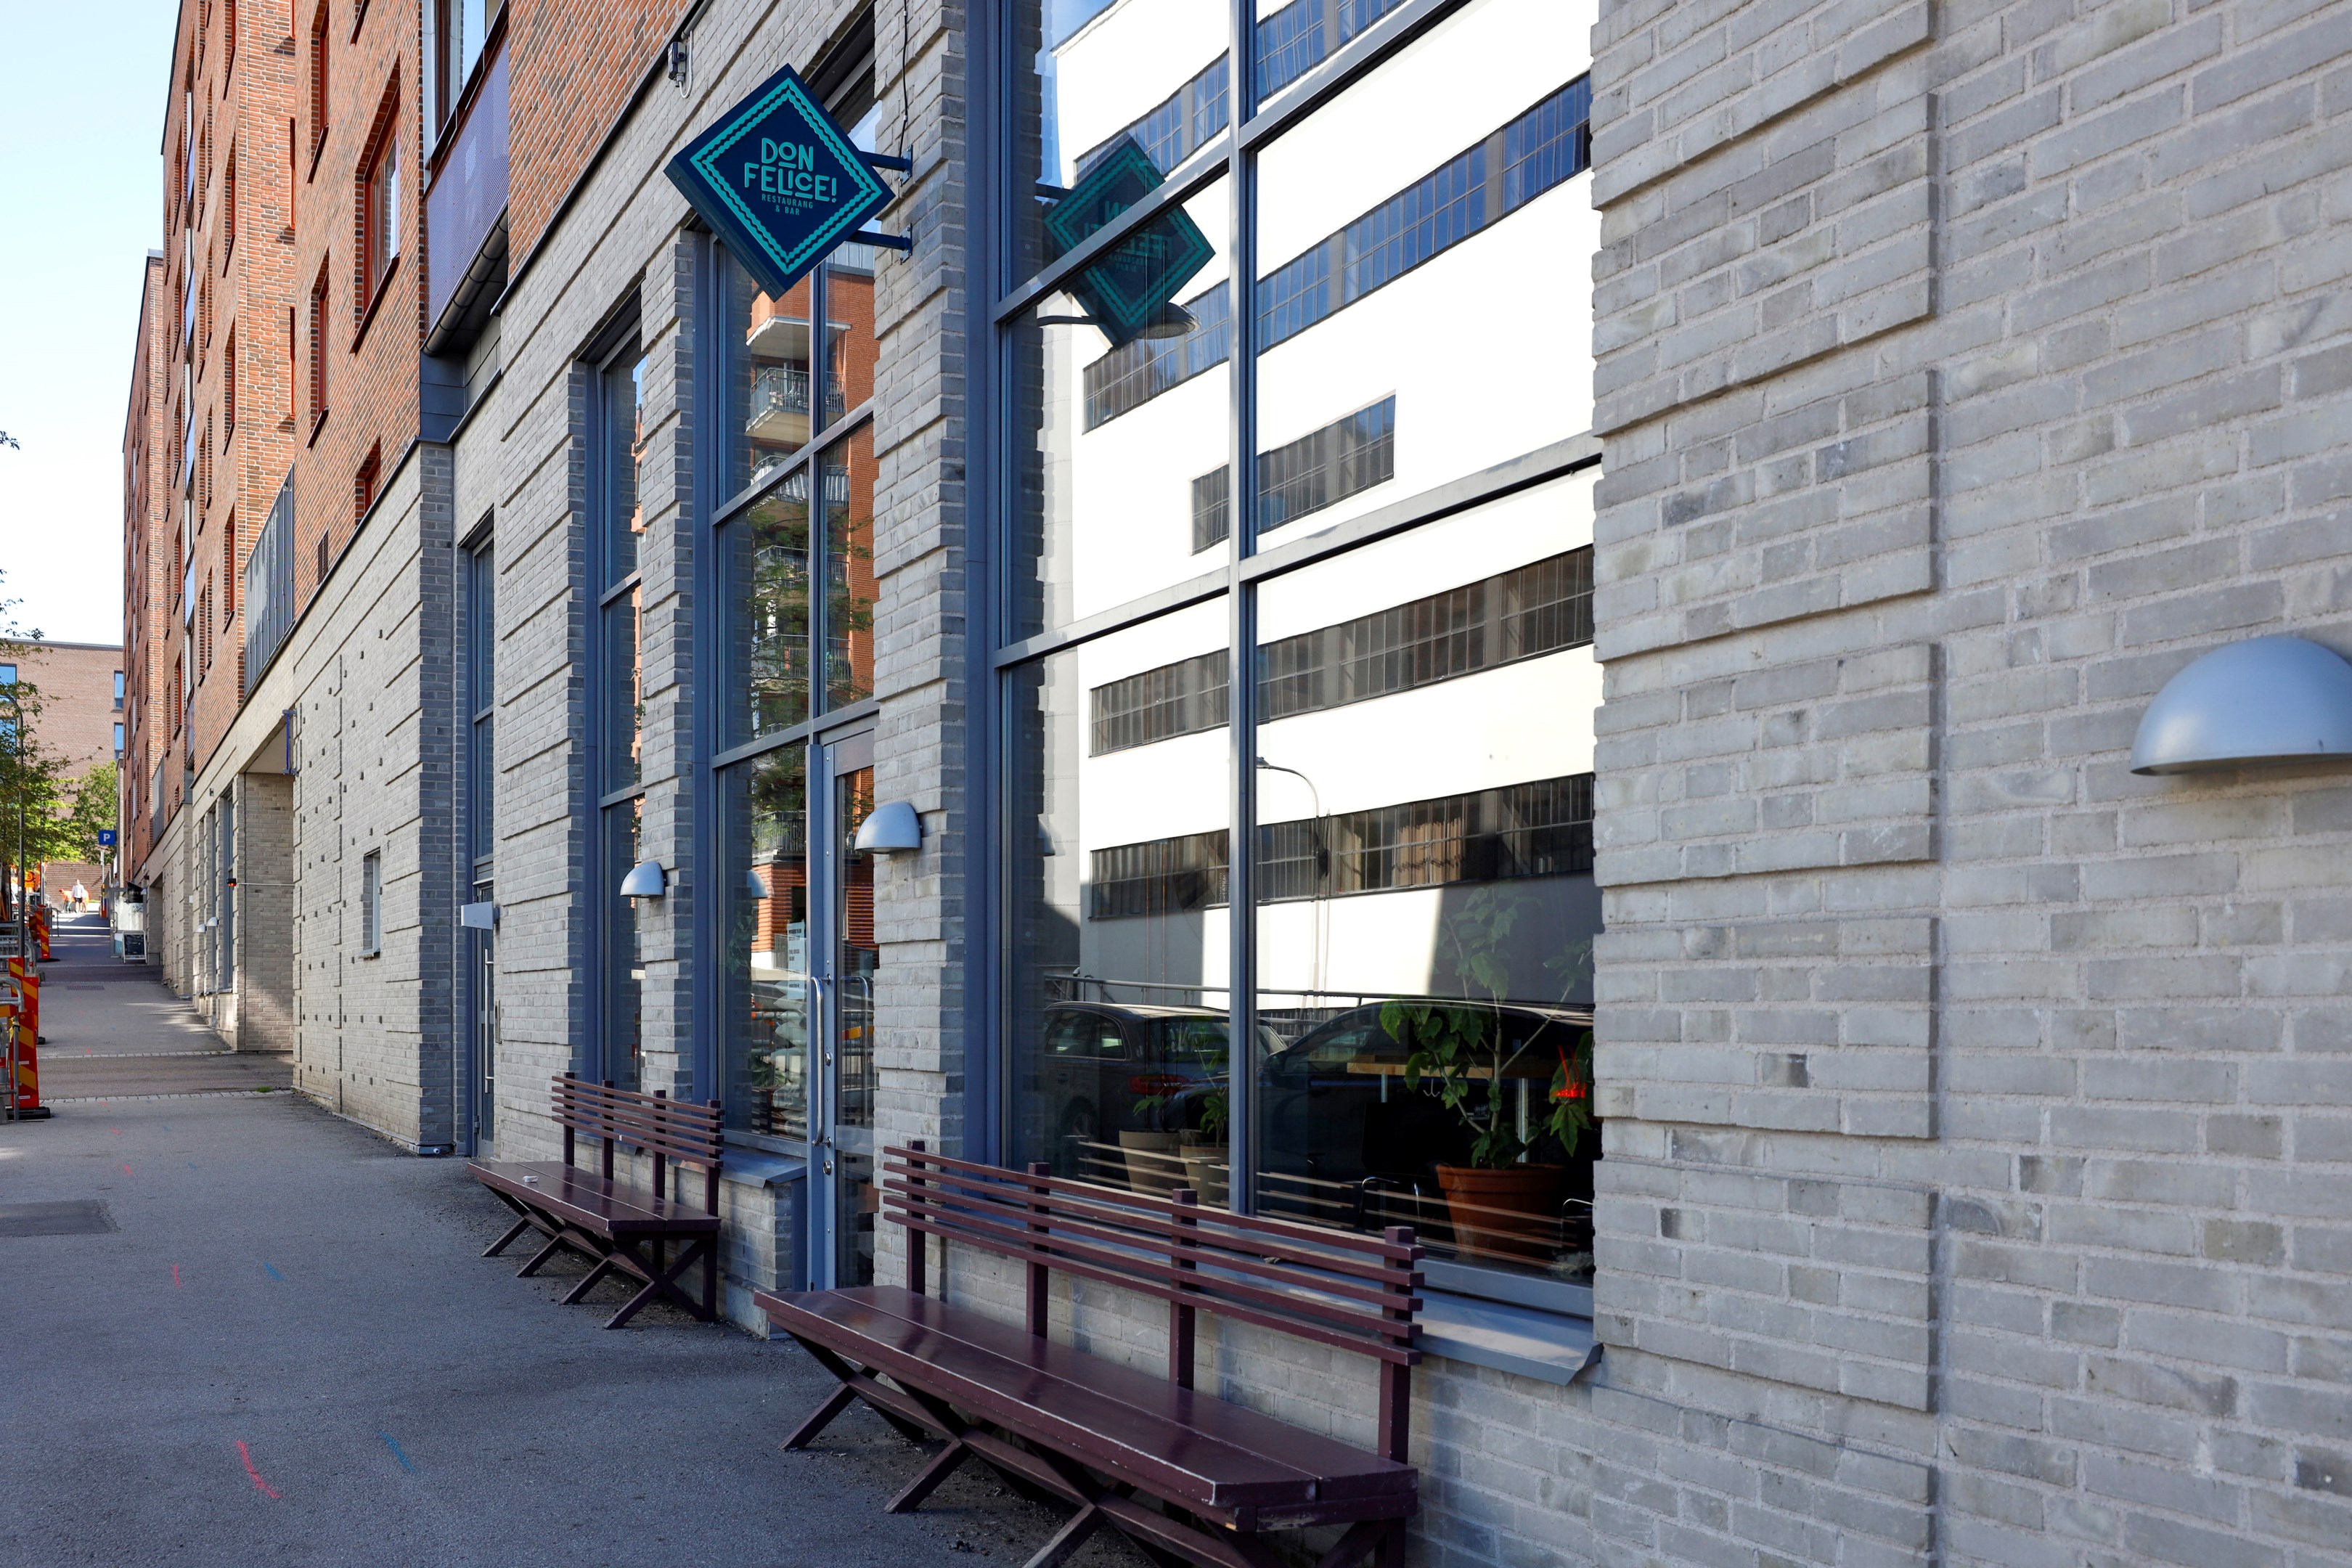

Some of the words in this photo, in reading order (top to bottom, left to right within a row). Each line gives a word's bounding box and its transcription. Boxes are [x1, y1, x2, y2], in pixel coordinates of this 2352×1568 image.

[761, 137, 814, 171] DON
[744, 162, 837, 203] FELICE!
[761, 193, 813, 209] RESTAURANG
[785, 206, 800, 216] BAR
[103, 833, 110, 842] P
